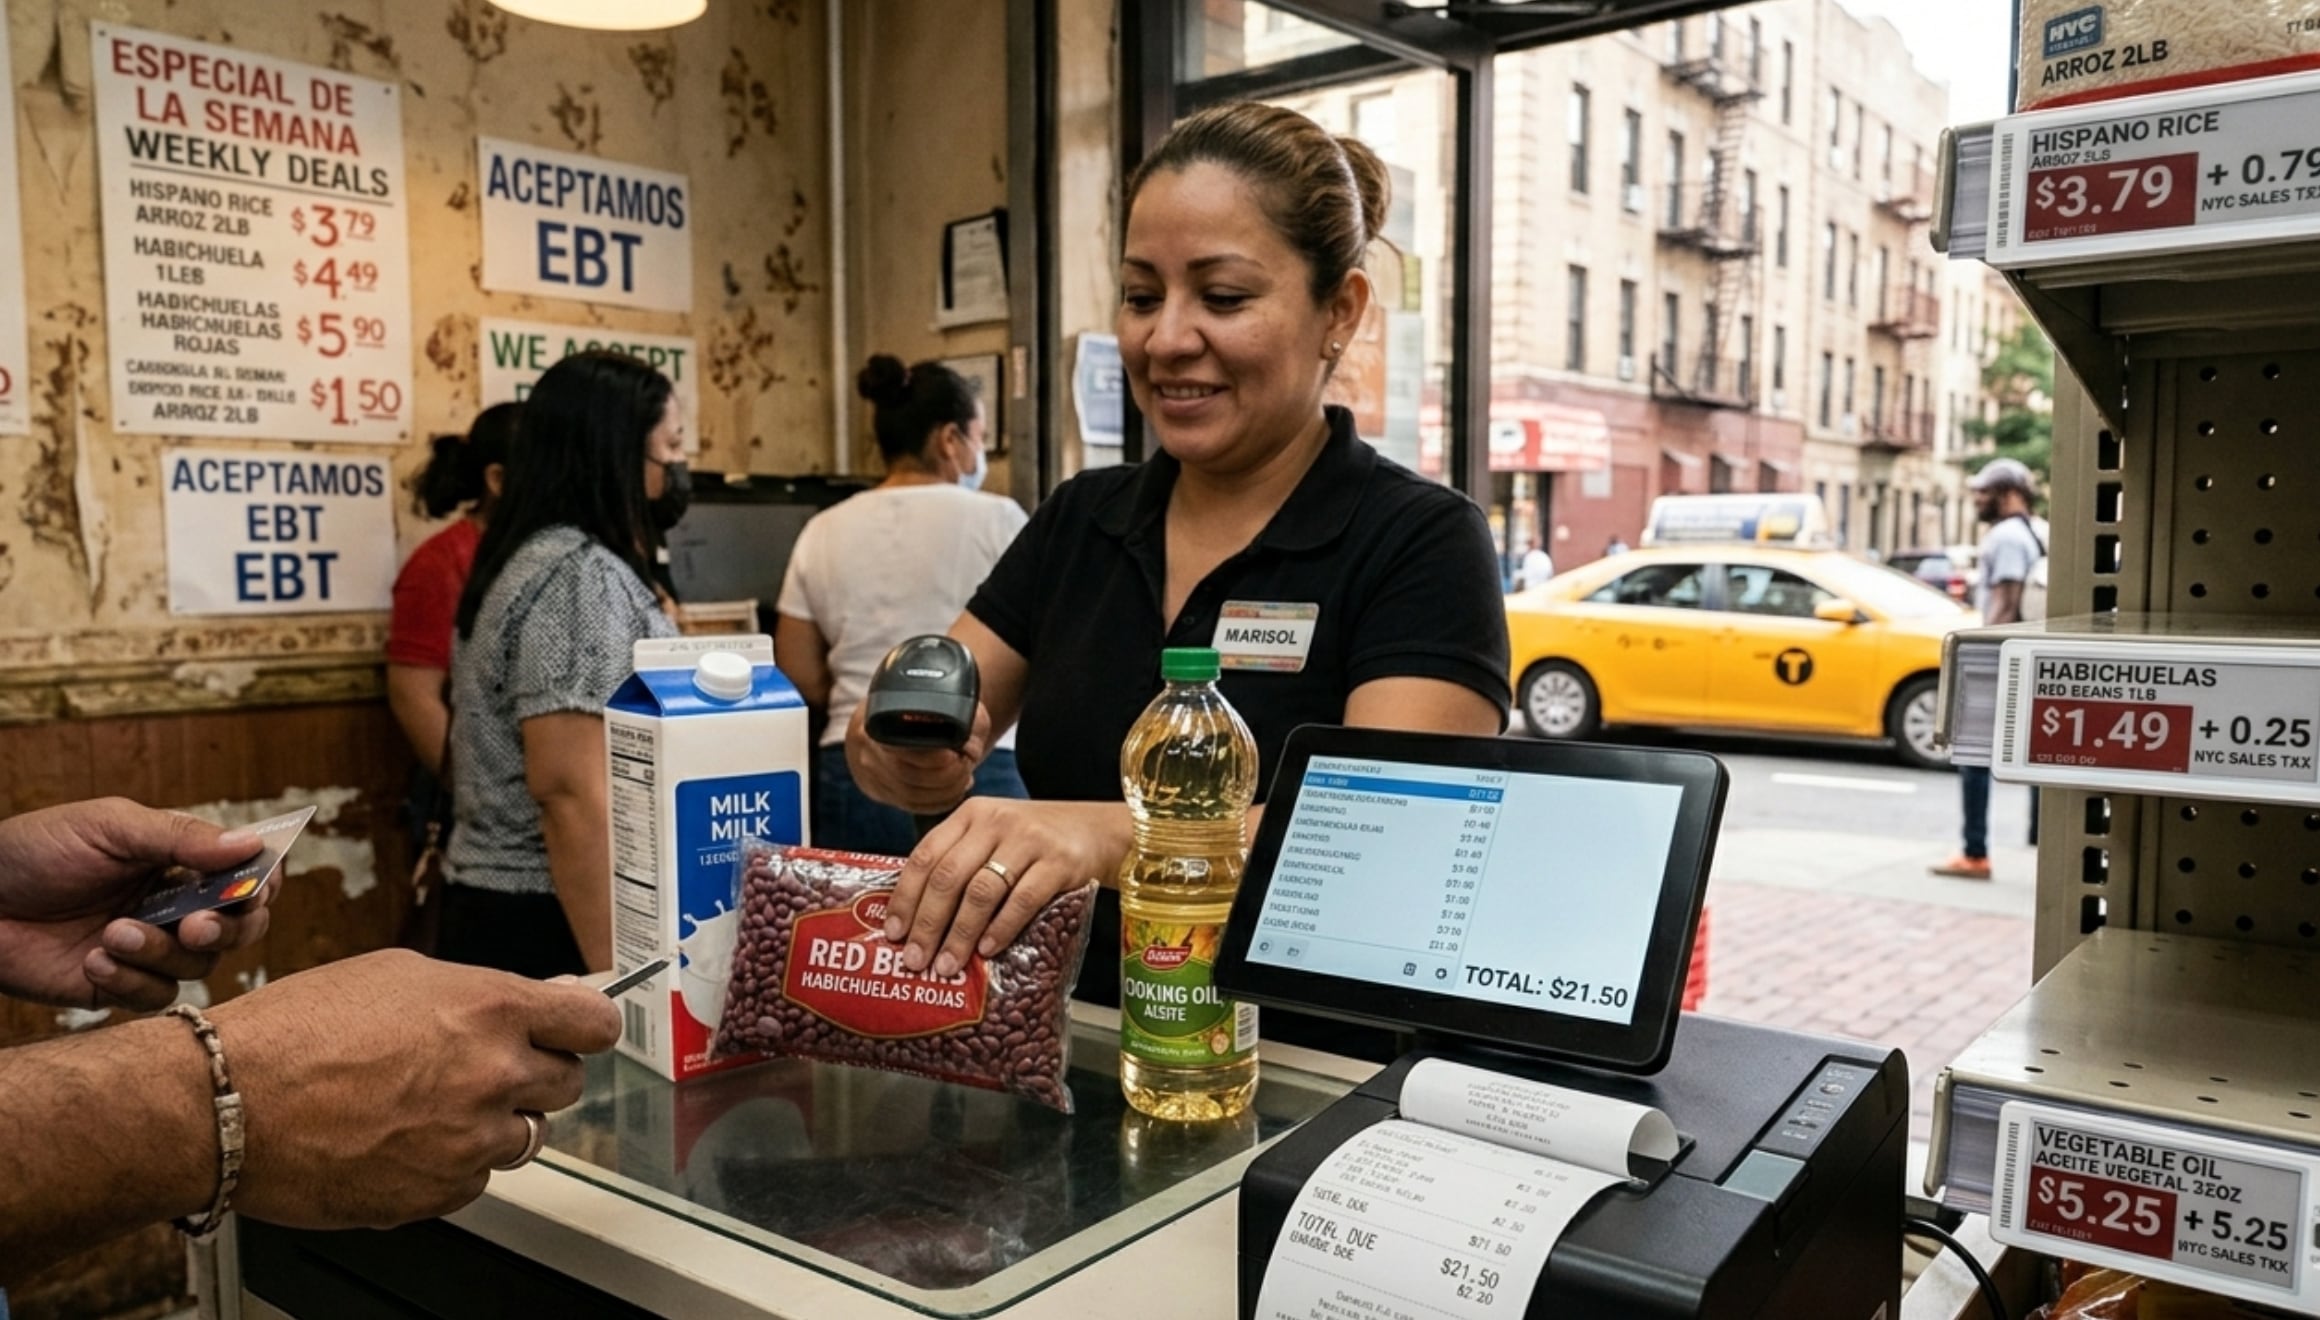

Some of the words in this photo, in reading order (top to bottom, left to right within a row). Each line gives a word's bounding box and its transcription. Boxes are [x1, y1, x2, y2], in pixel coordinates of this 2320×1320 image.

[111, 38, 294, 106] ESPECIAL
[310, 78, 354, 117] DE
[2041, 48, 2116, 87] ARROZ
[2121, 39, 2169, 68] 2LB
[136, 86, 188, 127] LA
[204, 99, 361, 157] SEMANA
[2032, 120, 2150, 153] HISPANO
[2158, 111, 2220, 138] RICE
[125, 126, 271, 177] WEEKLY
[288, 154, 390, 198] DEALS
[2207, 164, 2229, 186] +
[130, 178, 222, 209] HISPANO
[228, 192, 273, 217] RICE
[487, 154, 685, 230] ACEPTAMOS
[2035, 164, 2173, 217] $3.79
[2201, 195, 2235, 212] NYC
[2239, 189, 2290, 207] SALES
[136, 204, 207, 231] ARROZ
[212, 214, 251, 236] 2LB
[134, 235, 265, 269] HABICHUELA
[537, 220, 643, 293] EBT
[174, 334, 240, 356] ROJAS
[490, 330, 548, 371] WE
[224, 406, 259, 424] 2LB
[171, 458, 384, 497] ACEPTAMOS
[248, 504, 324, 542] EBT
[236, 552, 339, 602] EBT
[1224, 628, 1298, 645] MARISOL
[2037, 683, 2067, 696] RED
[2038, 662, 2217, 688] HABICHUELAS
[2041, 705, 2170, 751] $1.49
[2199, 719, 2219, 739] +
[2230, 715, 2311, 748] 0.25
[2194, 750, 2225, 764] NYC
[2228, 751, 2277, 767] SALES
[710, 791, 771, 816] MILK
[711, 816, 771, 842] MILK
[808, 938, 866, 971] RED
[801, 972, 911, 1001] HABICHUELAS
[914, 986, 965, 1008] ROJAS
[1465, 965, 1544, 995] TOTAL:
[1549, 976, 1628, 1008] $21.50
[2035, 1150, 2100, 1174] ACEITE
[2104, 1162, 2188, 1192] VEGETAL
[2038, 1127, 2176, 1171] VEGETABLE
[2182, 1155, 2222, 1180] OIL
[2037, 1175, 2161, 1236] $5.25
[2183, 1210, 2204, 1231] +
[2211, 1210, 2288, 1252] 5.25
[1440, 1257, 1500, 1289] $21.50
[2211, 1246, 2256, 1266] SALES
